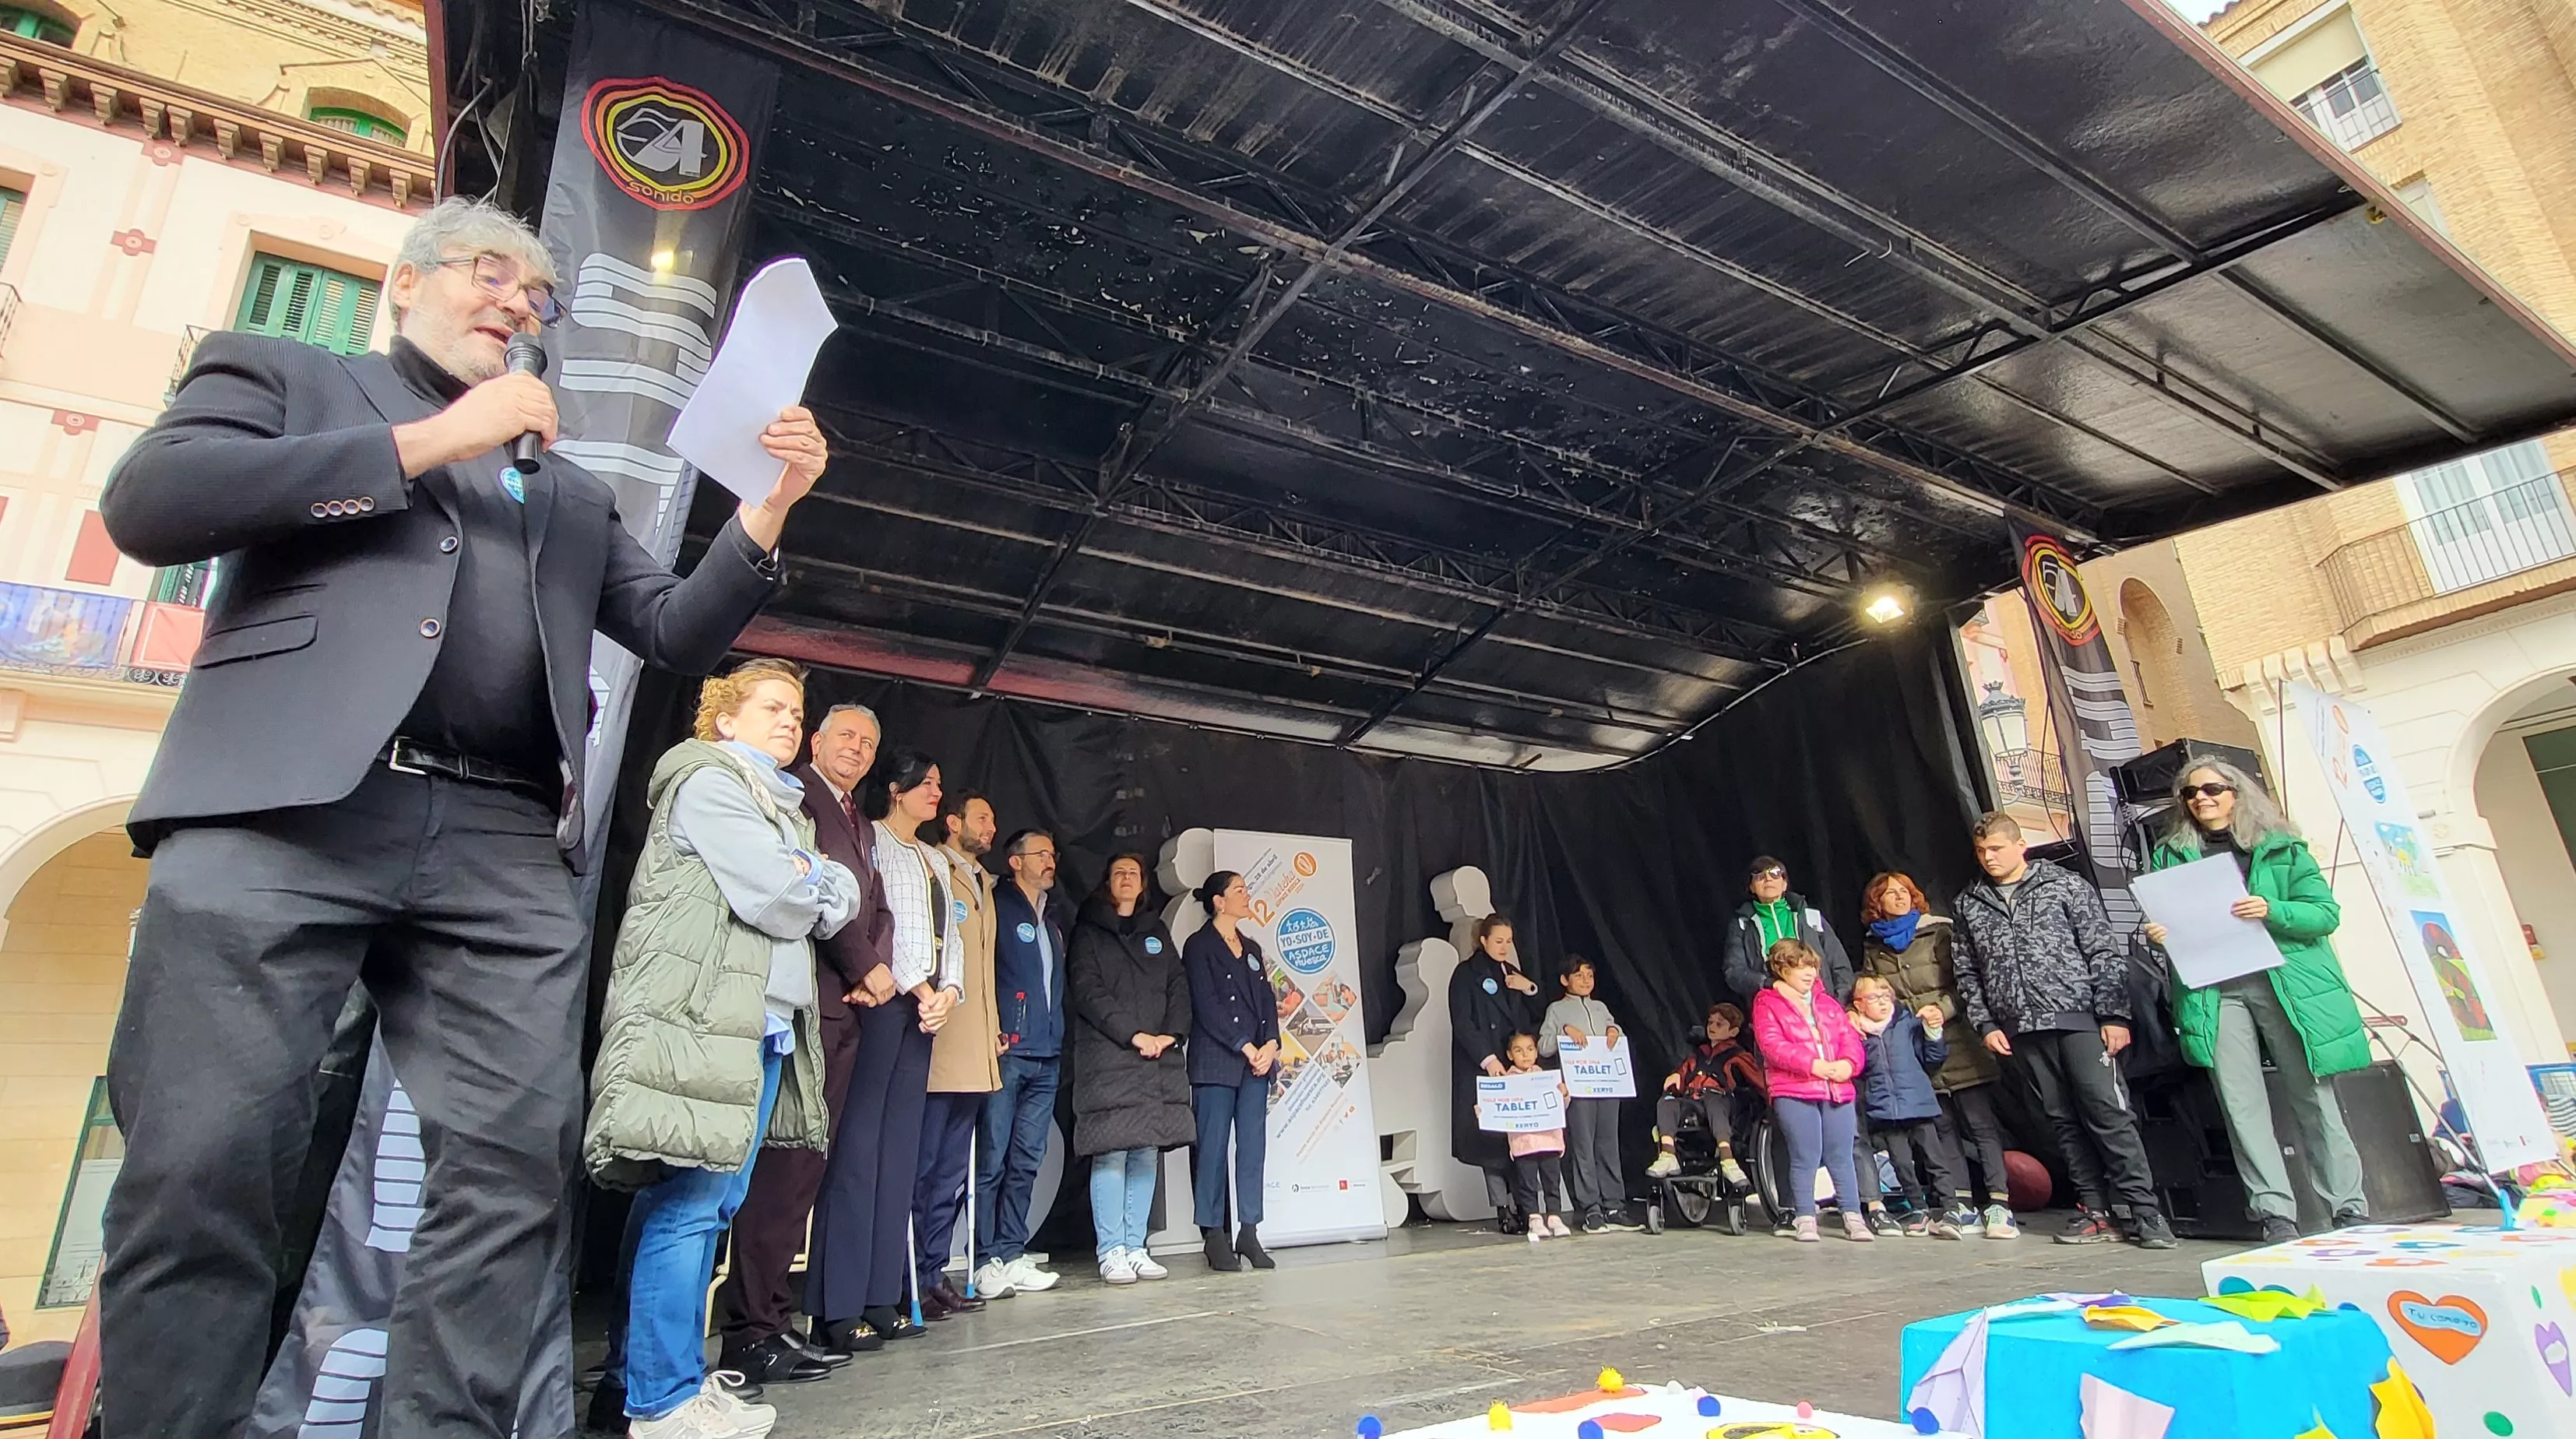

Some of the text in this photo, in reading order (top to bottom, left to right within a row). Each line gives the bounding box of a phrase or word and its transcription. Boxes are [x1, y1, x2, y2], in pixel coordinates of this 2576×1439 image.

[627, 180, 694, 205] sonido
[1267, 853, 1278, 867] abril
[1289, 944, 1330, 961] ASPACE
[1574, 1065, 1611, 1075] TABLET
[1495, 1100, 1538, 1112] TABLET
[2408, 1307, 2425, 1319] TU
